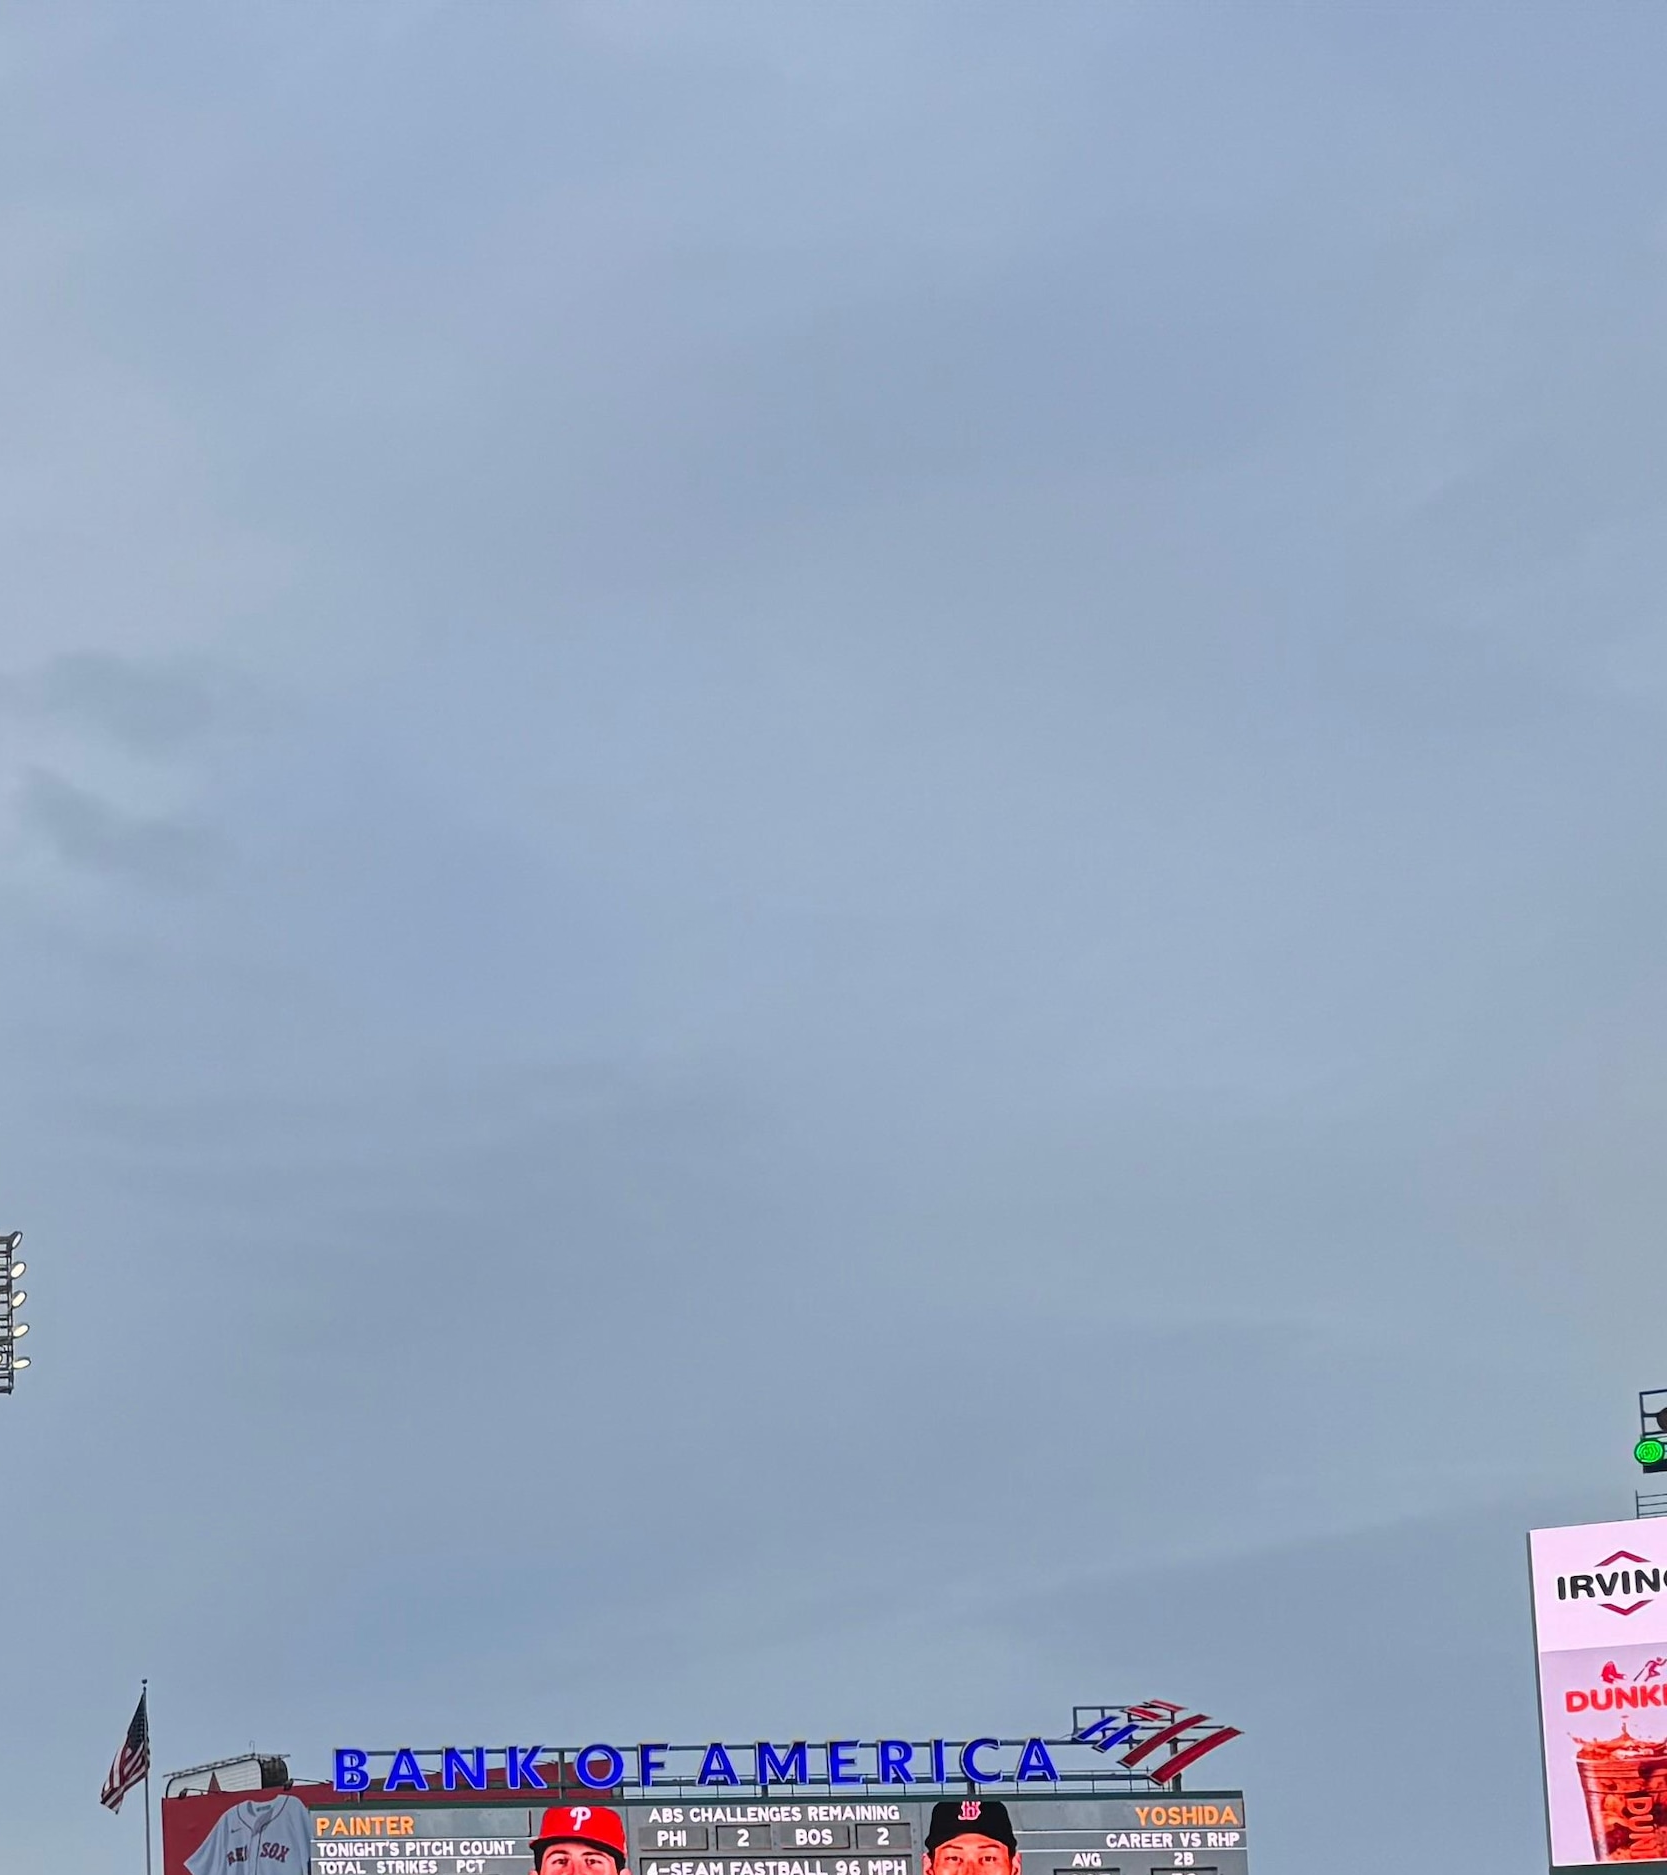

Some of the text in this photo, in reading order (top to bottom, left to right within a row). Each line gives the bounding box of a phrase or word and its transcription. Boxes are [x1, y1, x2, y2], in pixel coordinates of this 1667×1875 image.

[332, 1737, 1061, 1792] BANK OF AMERICA
[648, 1805, 900, 1823] ABS CHALLENGES REMAINING
[1135, 1806, 1238, 1826] YOSHIDA
[316, 1816, 414, 1837] PAINTER
[656, 1828, 890, 1847] PHI 2 BOS 2
[1106, 1832, 1240, 1849] CAREER VS RHP
[260, 1842, 290, 1864] SOX
[317, 1840, 515, 1857] TONIGHT'S PITCH COUNT
[318, 1858, 485, 1875] TOTAL STRIKES PCT
[868, 1860, 907, 1875] MPH
[1071, 1852, 1194, 1868] AVG 2B
